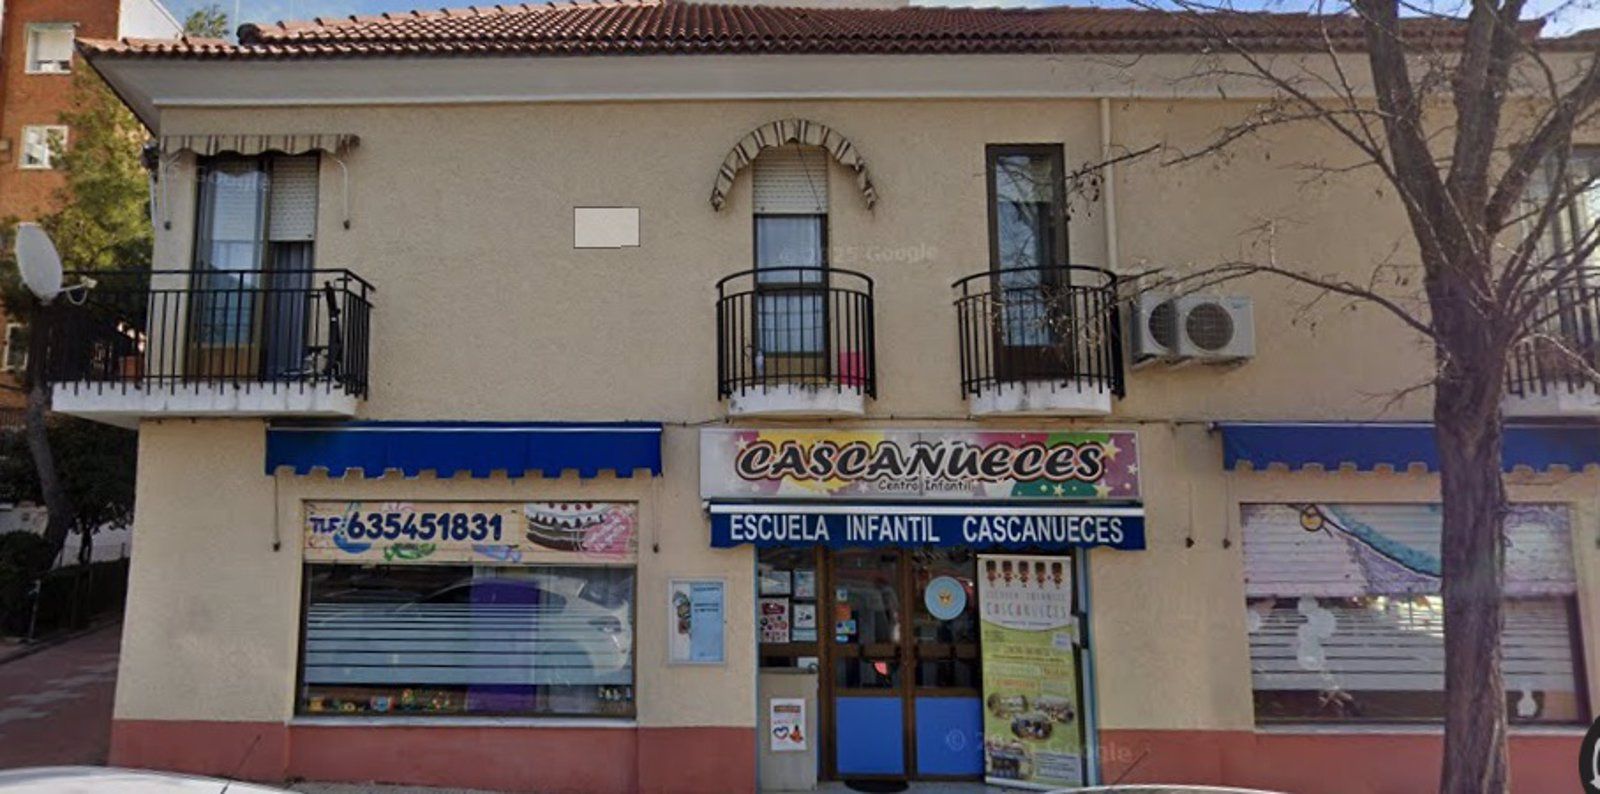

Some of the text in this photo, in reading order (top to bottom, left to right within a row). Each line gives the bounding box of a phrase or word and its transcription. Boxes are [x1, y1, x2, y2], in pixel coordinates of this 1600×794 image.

[736, 440, 1105, 480] CASCANUECES
[878, 479, 973, 491] Centro Infantil
[347, 511, 502, 541] 635451831
[730, 514, 1124, 543] ESCUELA INFANTIL CASCANUECES
